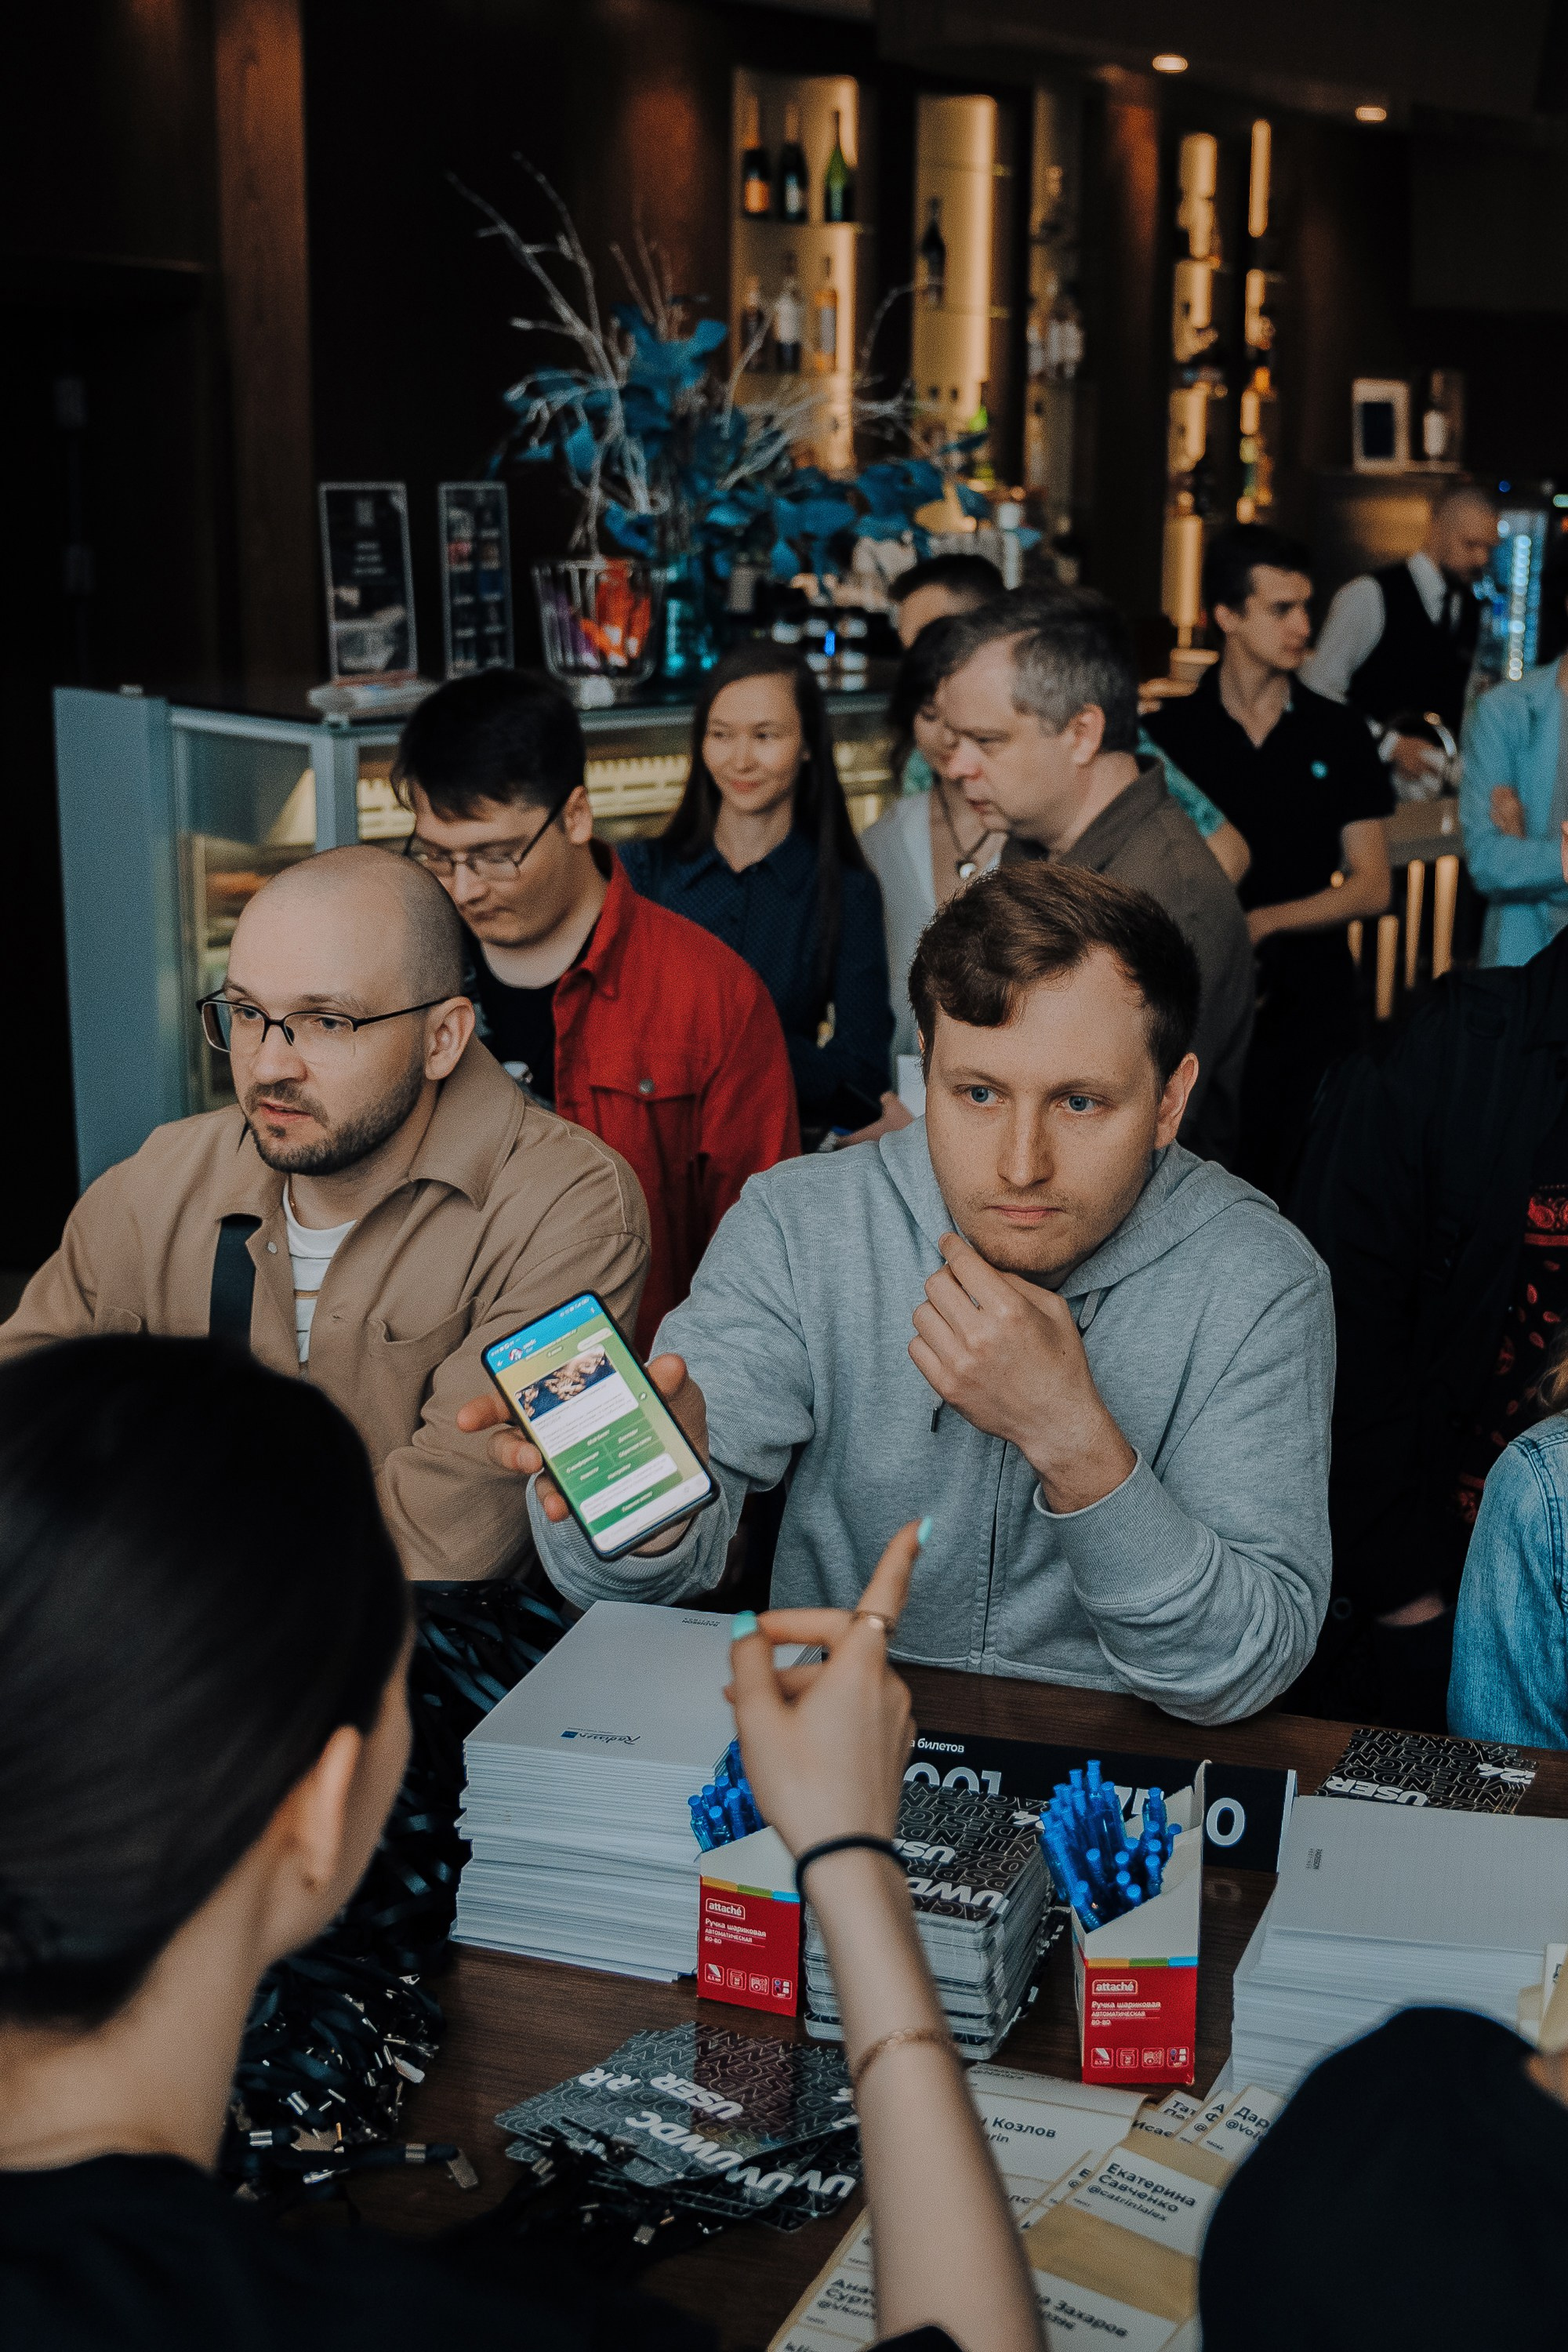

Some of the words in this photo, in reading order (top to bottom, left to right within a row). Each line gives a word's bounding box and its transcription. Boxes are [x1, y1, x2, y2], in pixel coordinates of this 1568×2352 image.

[917, 1737, 965, 1753] билетов
[1326, 1775, 1428, 1806] USER
[708, 1901, 742, 1916] attaché
[705, 1918, 726, 1929] Ручка
[727, 1923, 767, 1937] шариковая
[705, 1928, 753, 1943] АВТОМАТИЧЕСКАЯ
[1095, 1981, 1134, 1992] attaché
[1091, 2001, 1115, 2009] Ручка
[648, 2071, 743, 2120] USER
[992, 2117, 1057, 2138] Козлов
[625, 2110, 743, 2171] UWDC
[1098, 2174, 1179, 2213] Савченко
[1105, 2162, 1197, 2208] Екатерина
[1054, 2299, 1129, 2337] Захаров
